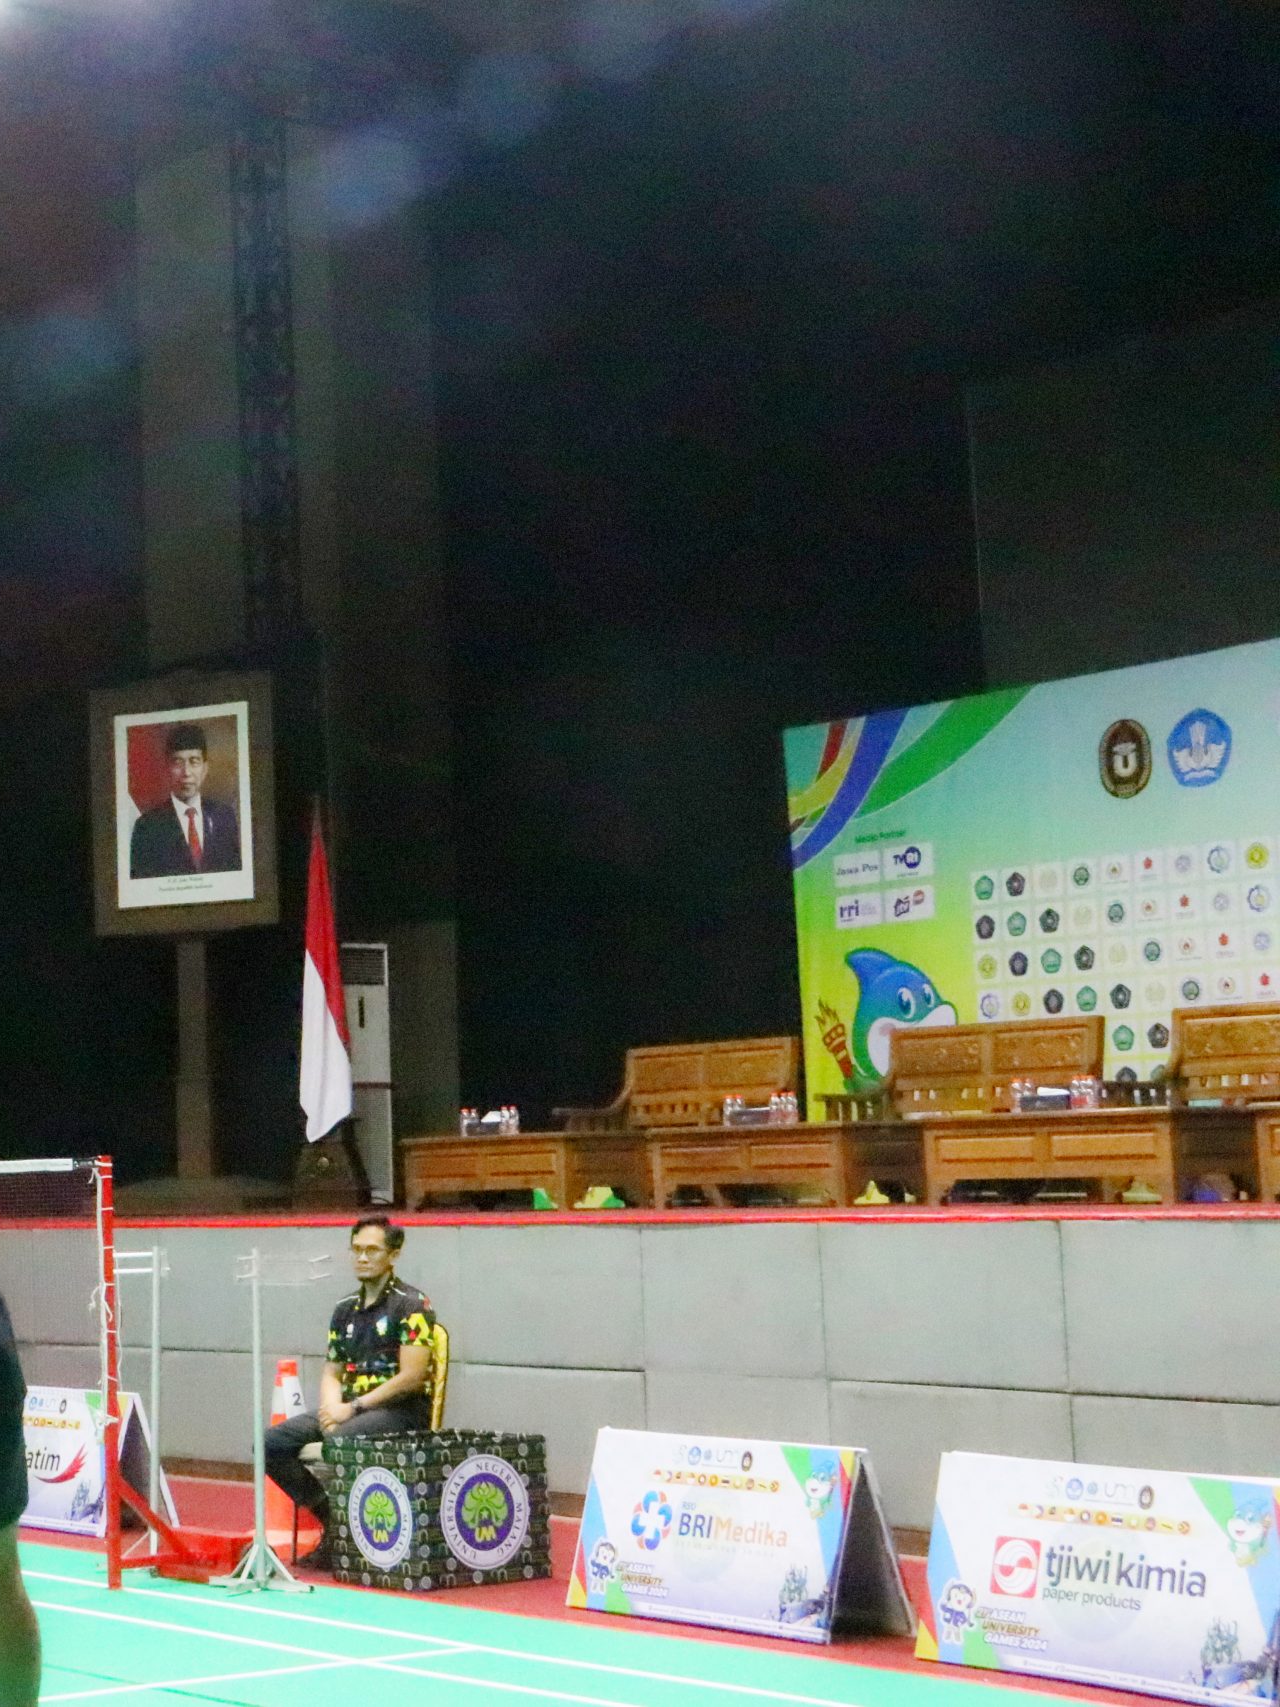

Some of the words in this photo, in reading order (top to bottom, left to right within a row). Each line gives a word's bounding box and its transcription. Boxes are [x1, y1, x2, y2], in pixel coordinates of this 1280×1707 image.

[292, 1392, 302, 1406] 2
[26, 1446, 61, 1471] atim
[476, 1462, 516, 1487] NEGERI
[446, 1475, 477, 1559] UNIVERSITAS
[373, 1529, 389, 1543] UM
[475, 1525, 497, 1543] UM
[1042, 1587, 1079, 1601] paper
[1082, 1592, 1142, 1611] products
[982, 1619, 1040, 1636] UNIVERSITY
[983, 1632, 1021, 1648] GAMES
[1020, 1636, 1048, 1652] 2024
